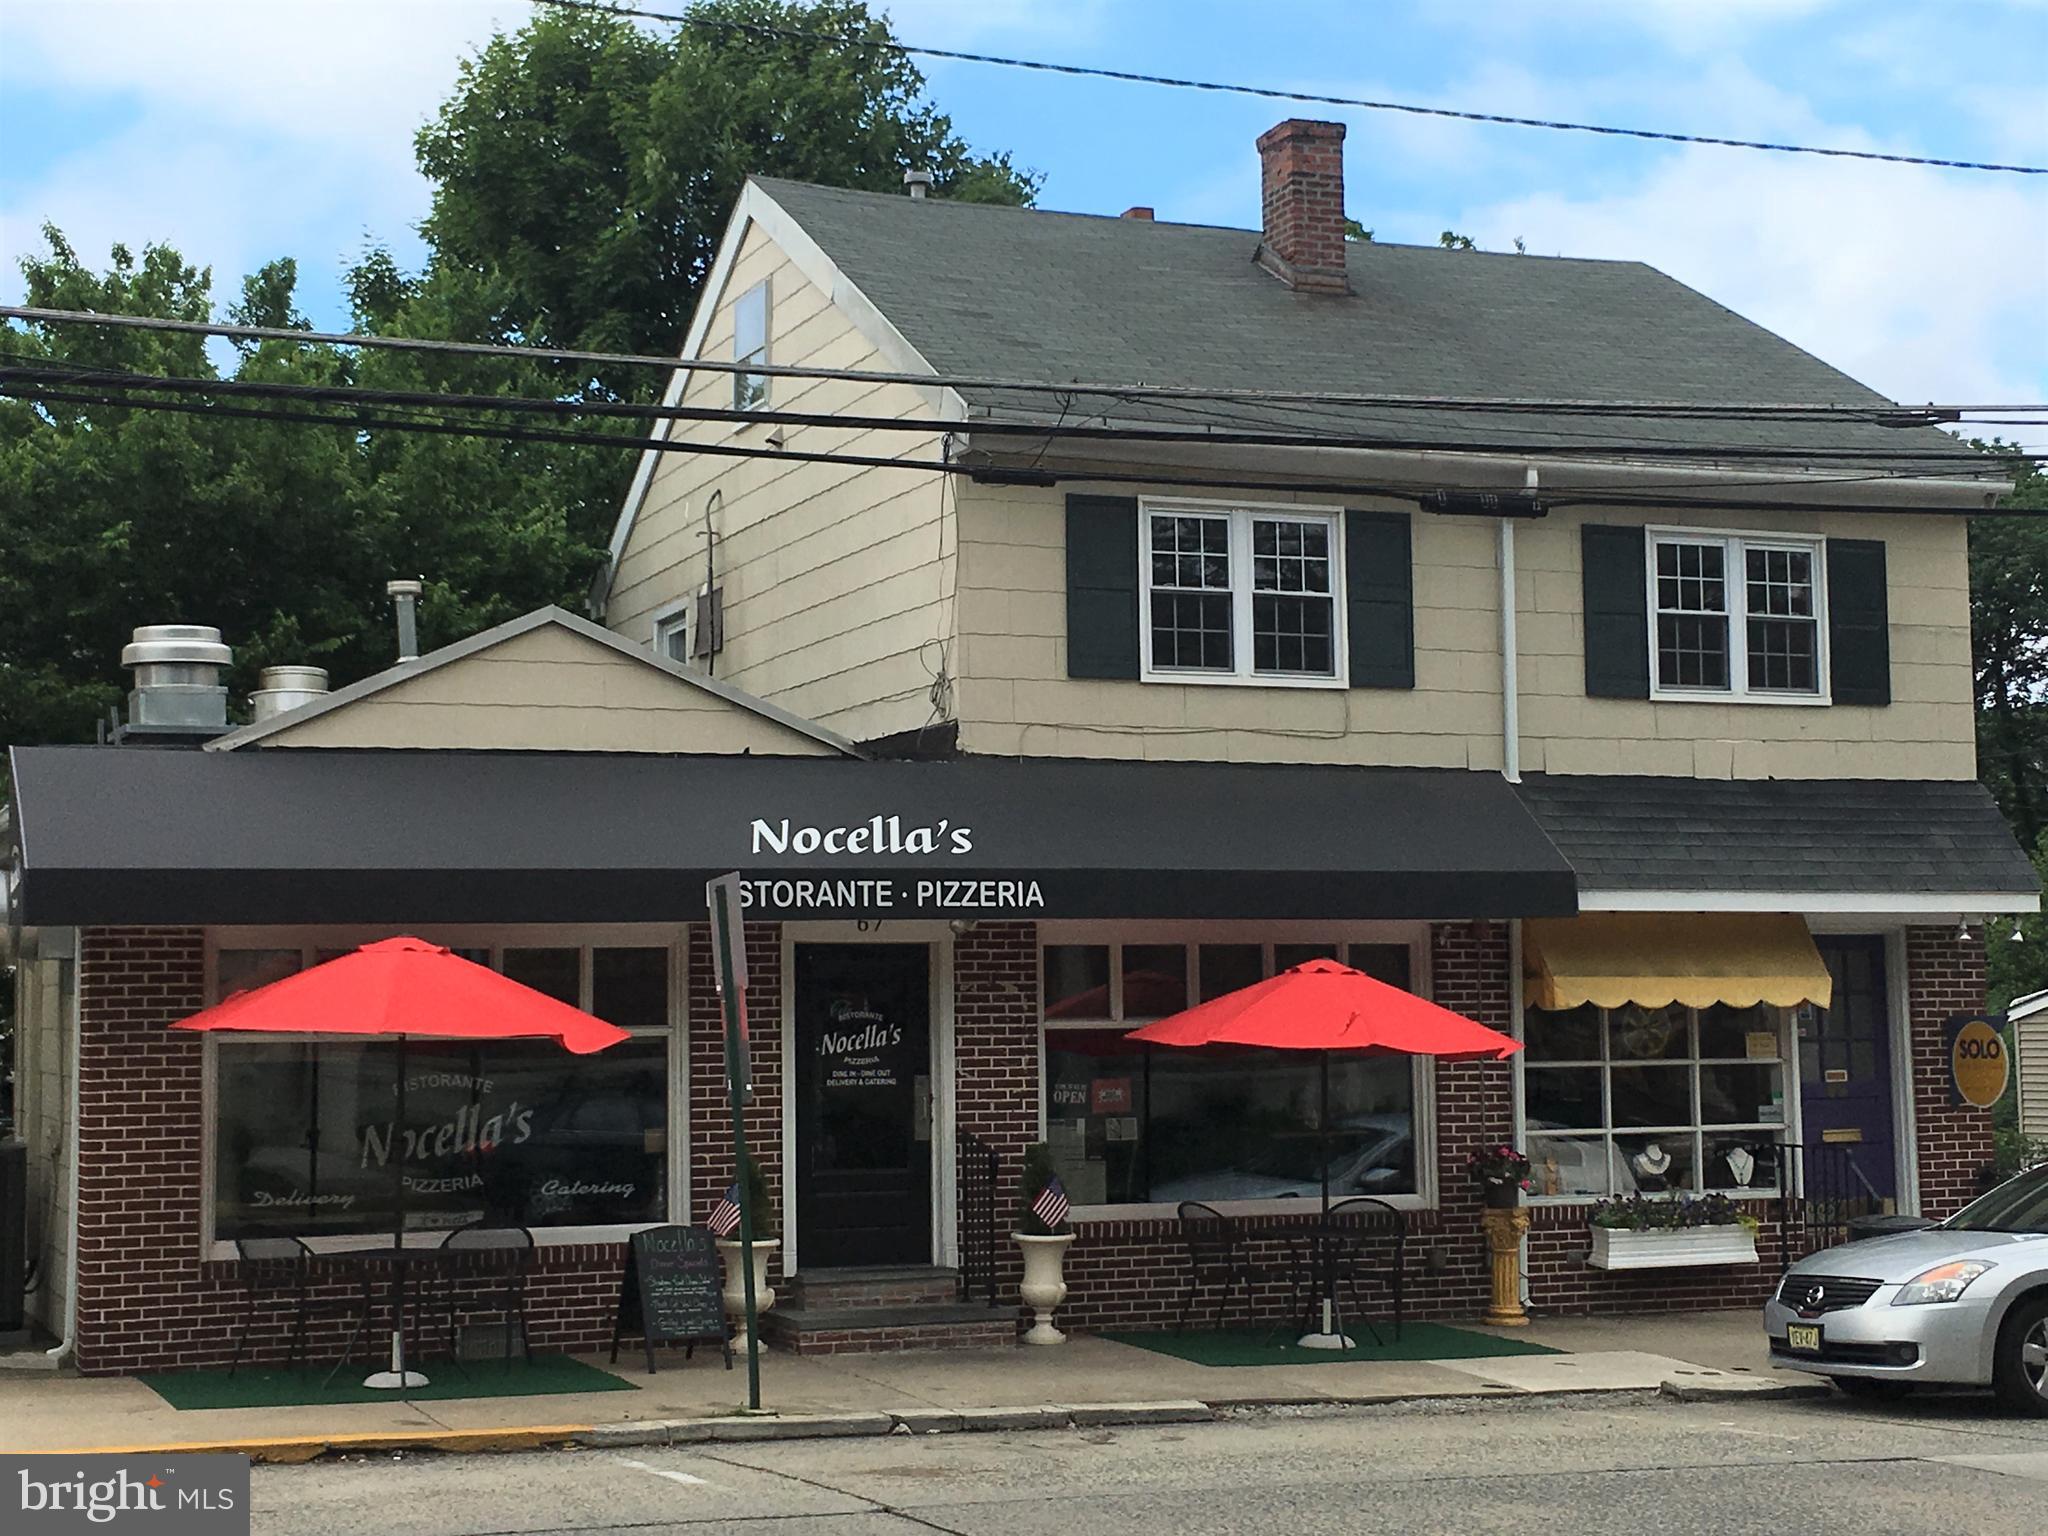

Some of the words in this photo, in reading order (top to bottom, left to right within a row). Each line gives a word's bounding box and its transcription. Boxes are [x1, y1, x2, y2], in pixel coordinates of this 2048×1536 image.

[750, 815, 973, 854] Nocella's
[706, 880, 893, 908] STORANTE
[917, 880, 1044, 908] PIZZERIA
[821, 1023, 902, 1056] Nocella's
[1959, 1039, 2000, 1059] SOLO
[843, 1056, 880, 1065] PIZZERIA
[826, 1079, 858, 1087] DELIVERY
[865, 1078, 897, 1086] CATERING
[877, 1069, 891, 1077] OUT
[1053, 1090, 1086, 1104] OPEN
[361, 1101, 535, 1170] Nocella's
[250, 1188, 355, 1210] Delivery
[541, 1179, 636, 1199] Catering
